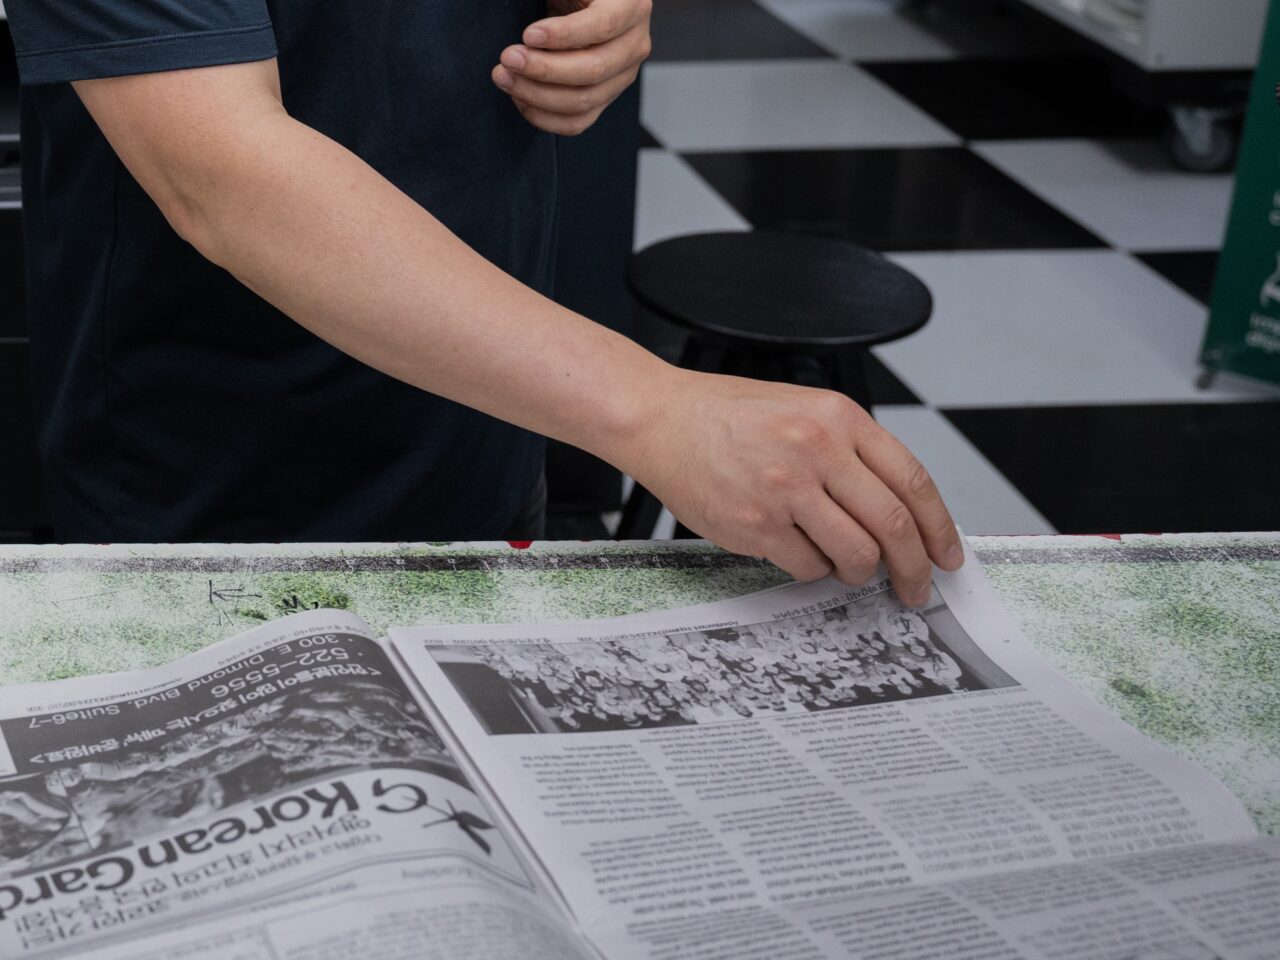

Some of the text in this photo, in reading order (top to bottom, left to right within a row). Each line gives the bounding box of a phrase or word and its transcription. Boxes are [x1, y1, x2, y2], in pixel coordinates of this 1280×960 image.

[271, 644, 293, 656] E.
[298, 633, 338, 647] 300
[187, 654, 265, 691] Dimond
[127, 688, 182, 710] Blvd.
[238, 682, 276, 705] 많이
[165, 697, 239, 731] 찾으시는
[258, 812, 371, 859] 앵커리지
[171, 849, 254, 889] 최고의
[113, 876, 169, 906] 한국
[90, 900, 168, 931] 코리안
[22, 921, 82, 950] 가든!
